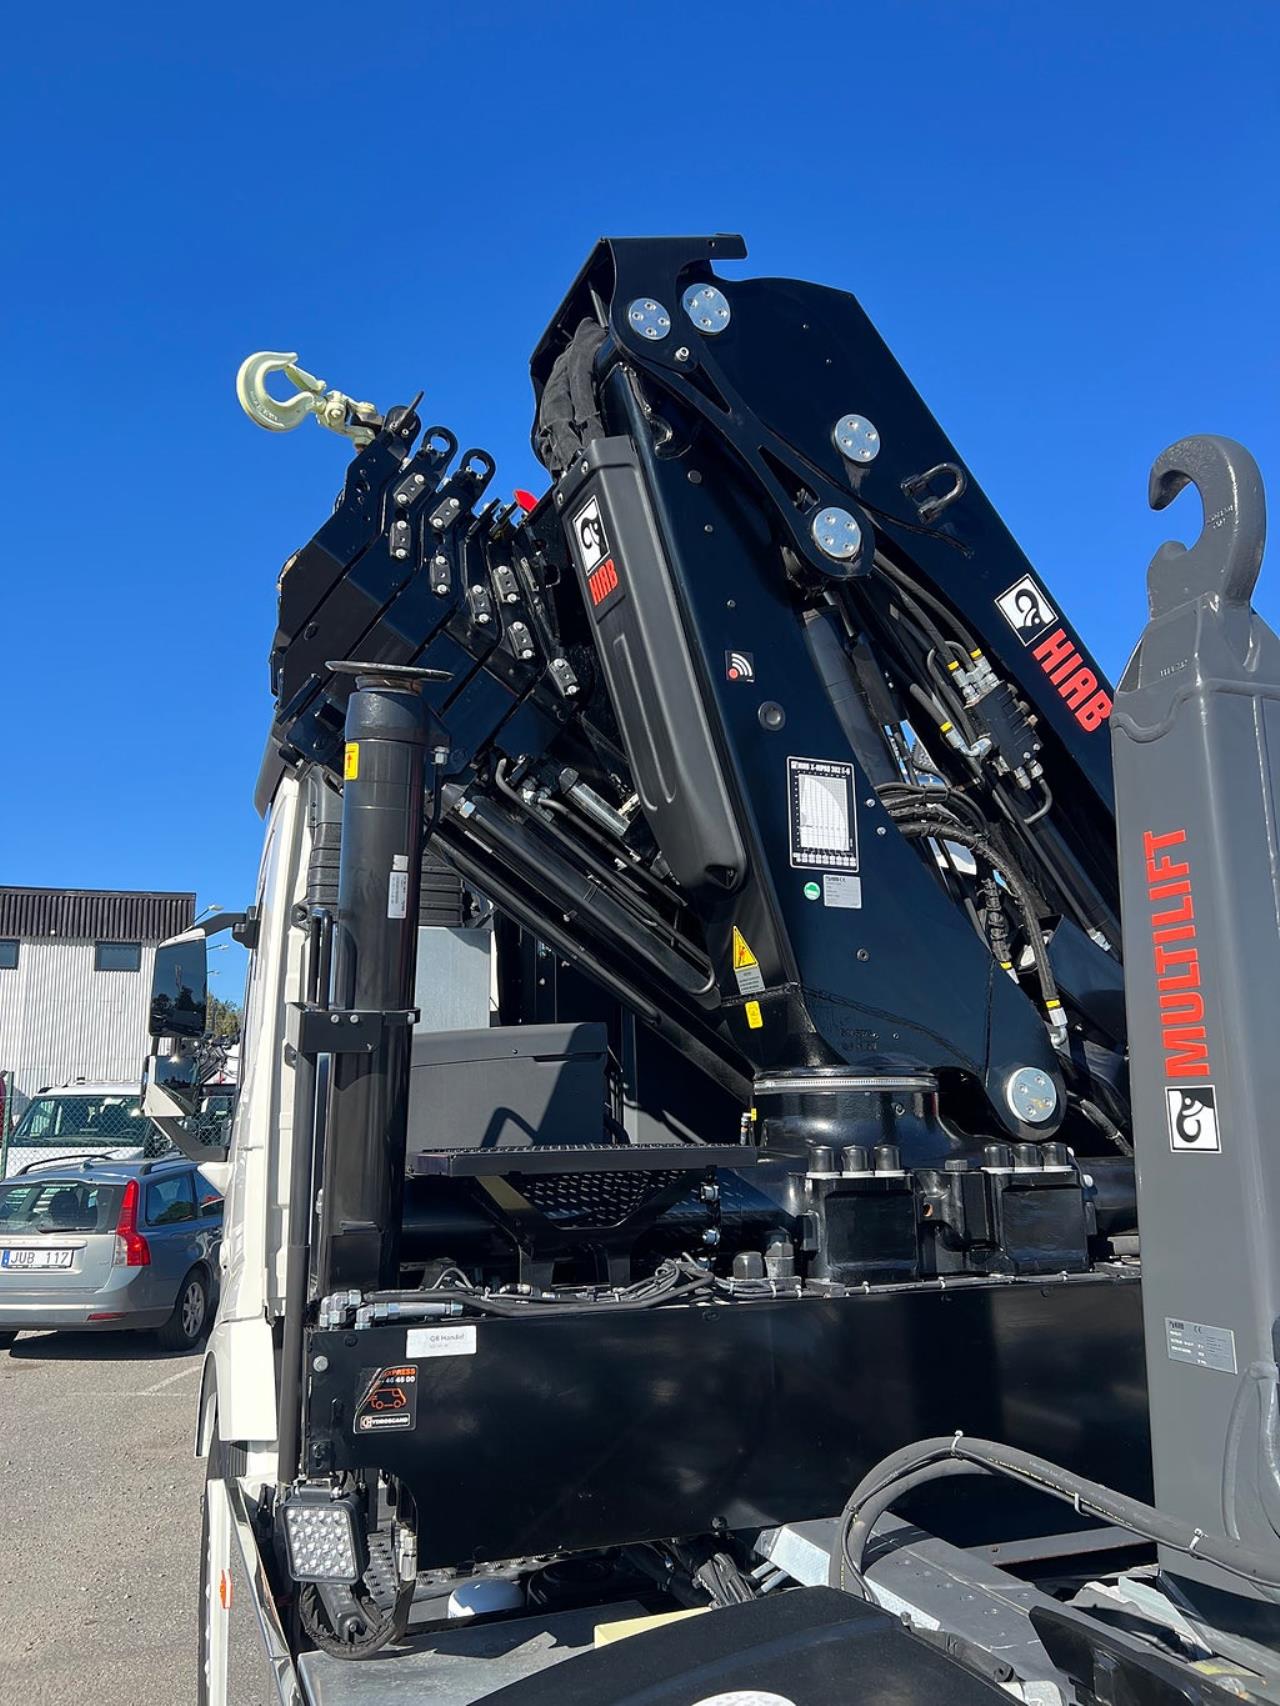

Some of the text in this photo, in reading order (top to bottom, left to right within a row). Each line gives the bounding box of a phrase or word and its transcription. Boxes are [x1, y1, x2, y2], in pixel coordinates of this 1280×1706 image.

[588, 558, 618, 606] HIAB
[1032, 628, 1113, 732] HIAB
[1143, 829, 1210, 1078] MULTILIFT
[10, 1251, 70, 1264] JUB 117
